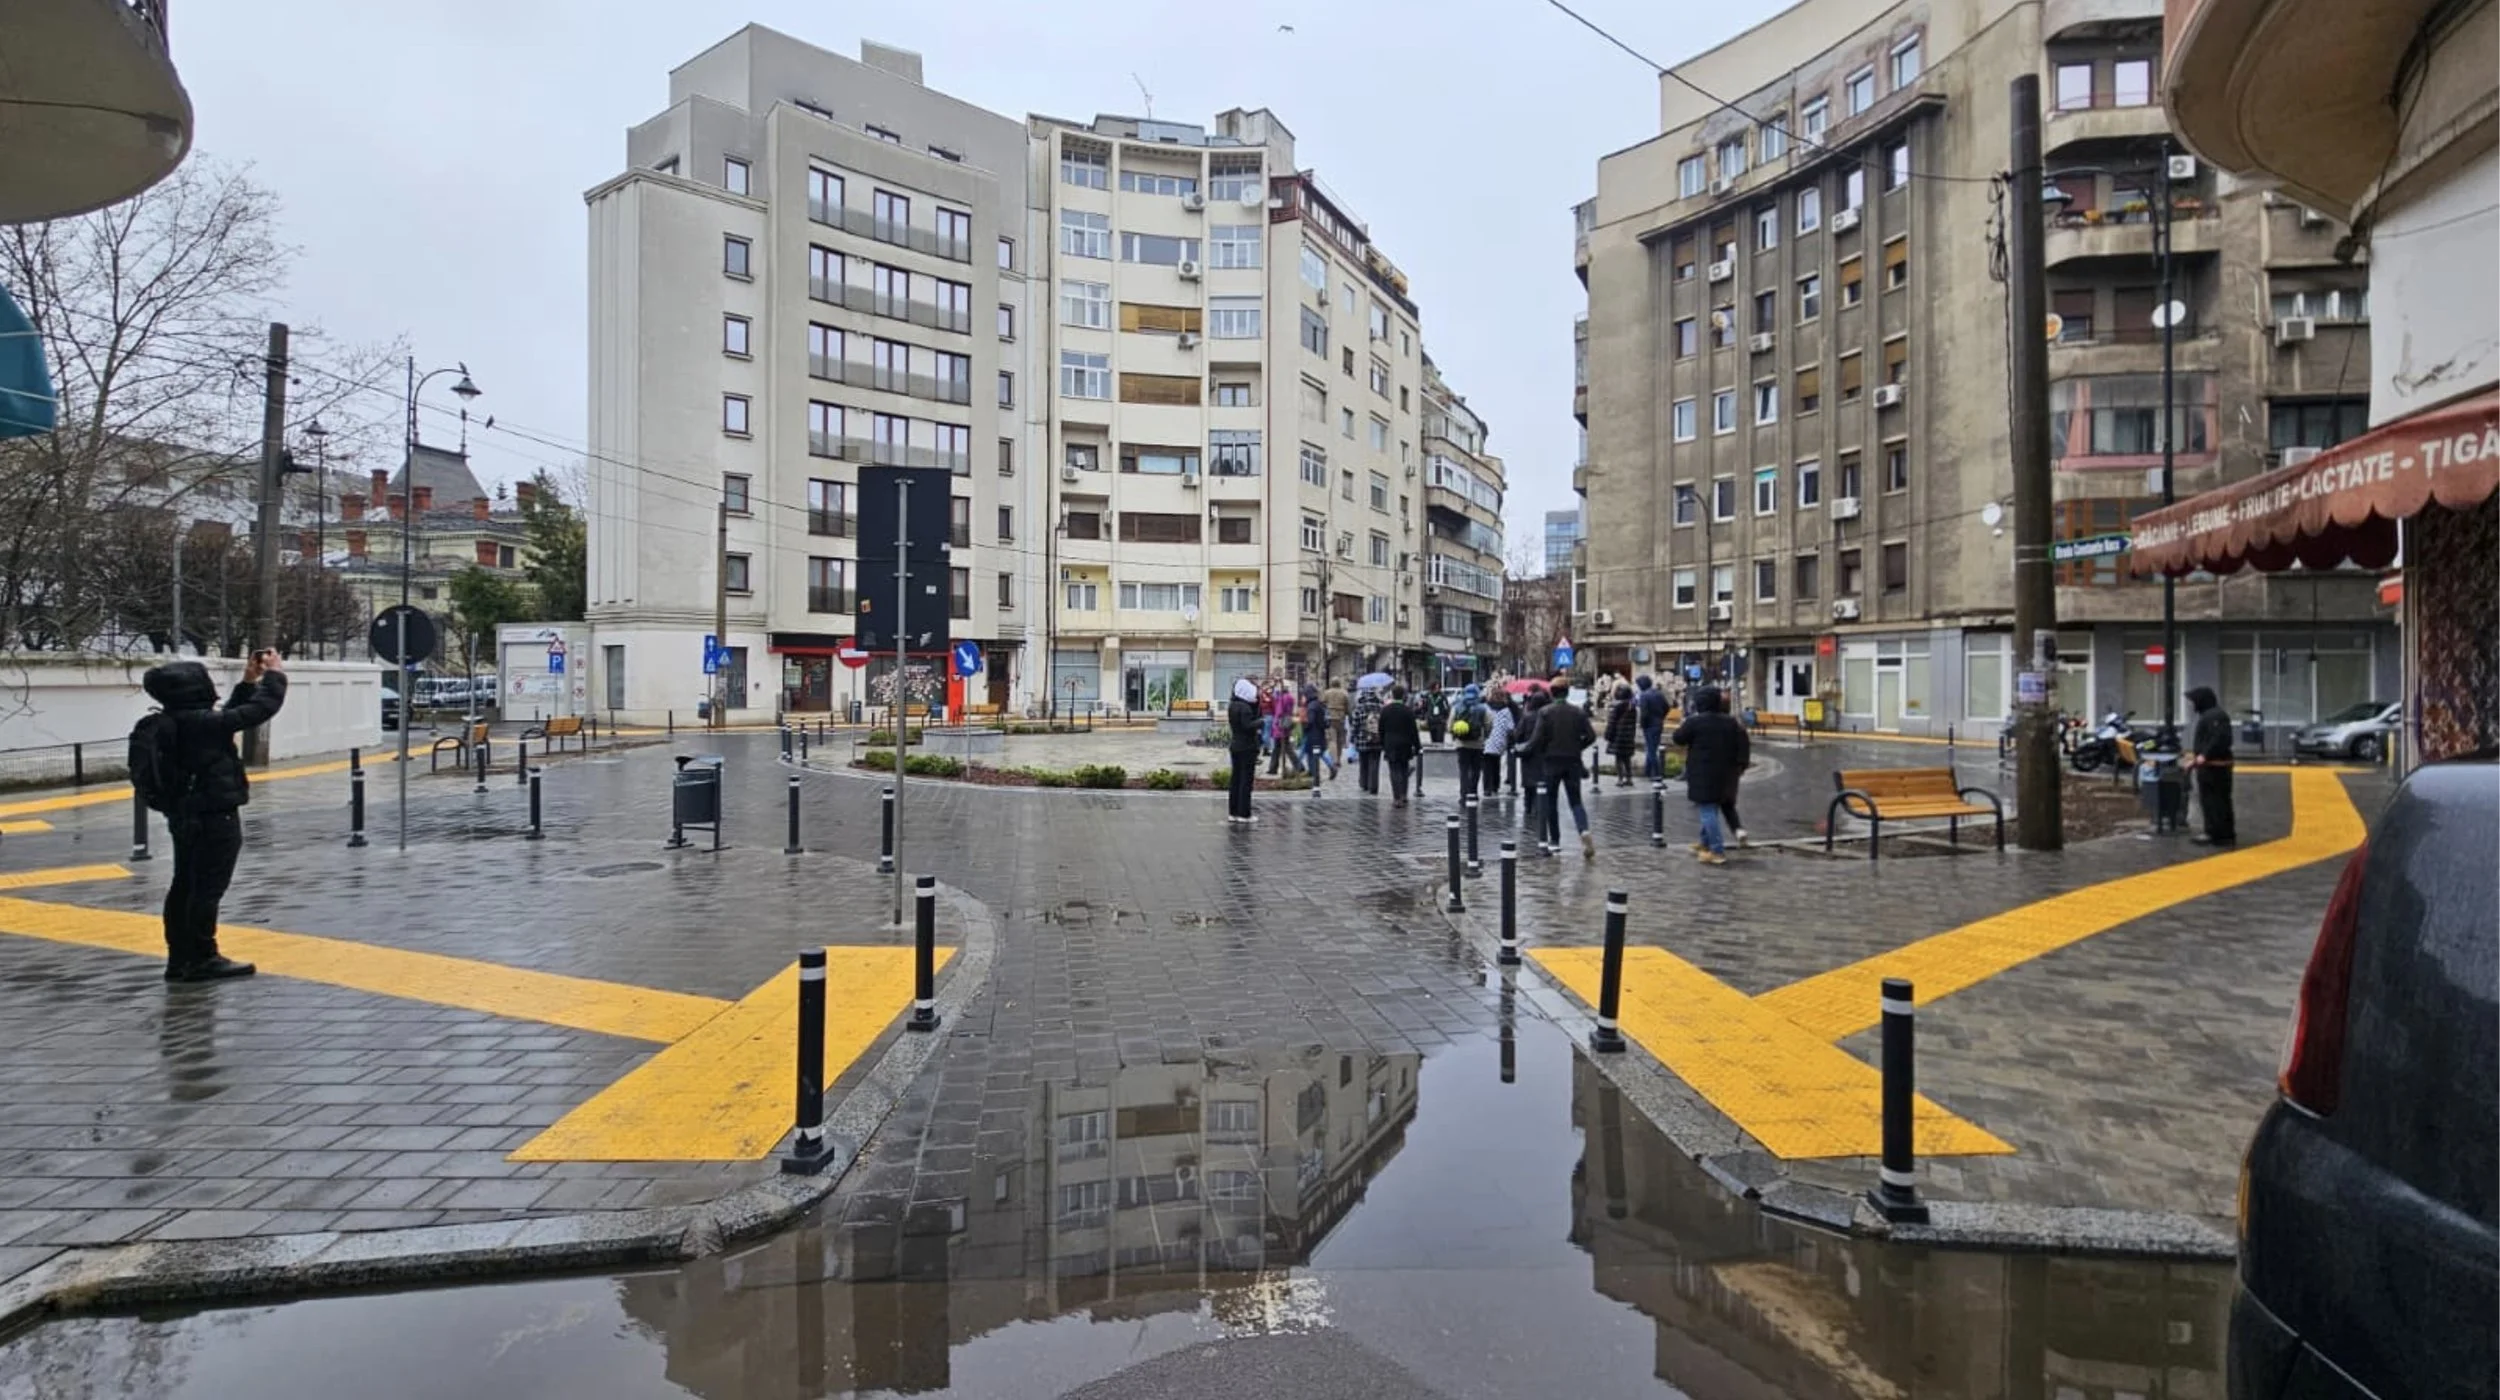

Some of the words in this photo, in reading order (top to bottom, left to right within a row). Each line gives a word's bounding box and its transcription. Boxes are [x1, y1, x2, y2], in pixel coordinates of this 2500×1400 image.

[2185, 503, 2231, 537] LEGUME
[2238, 482, 2291, 521] FRUCTE
[2299, 450, 2396, 500] LACTATE
[552, 655, 562, 669] P
